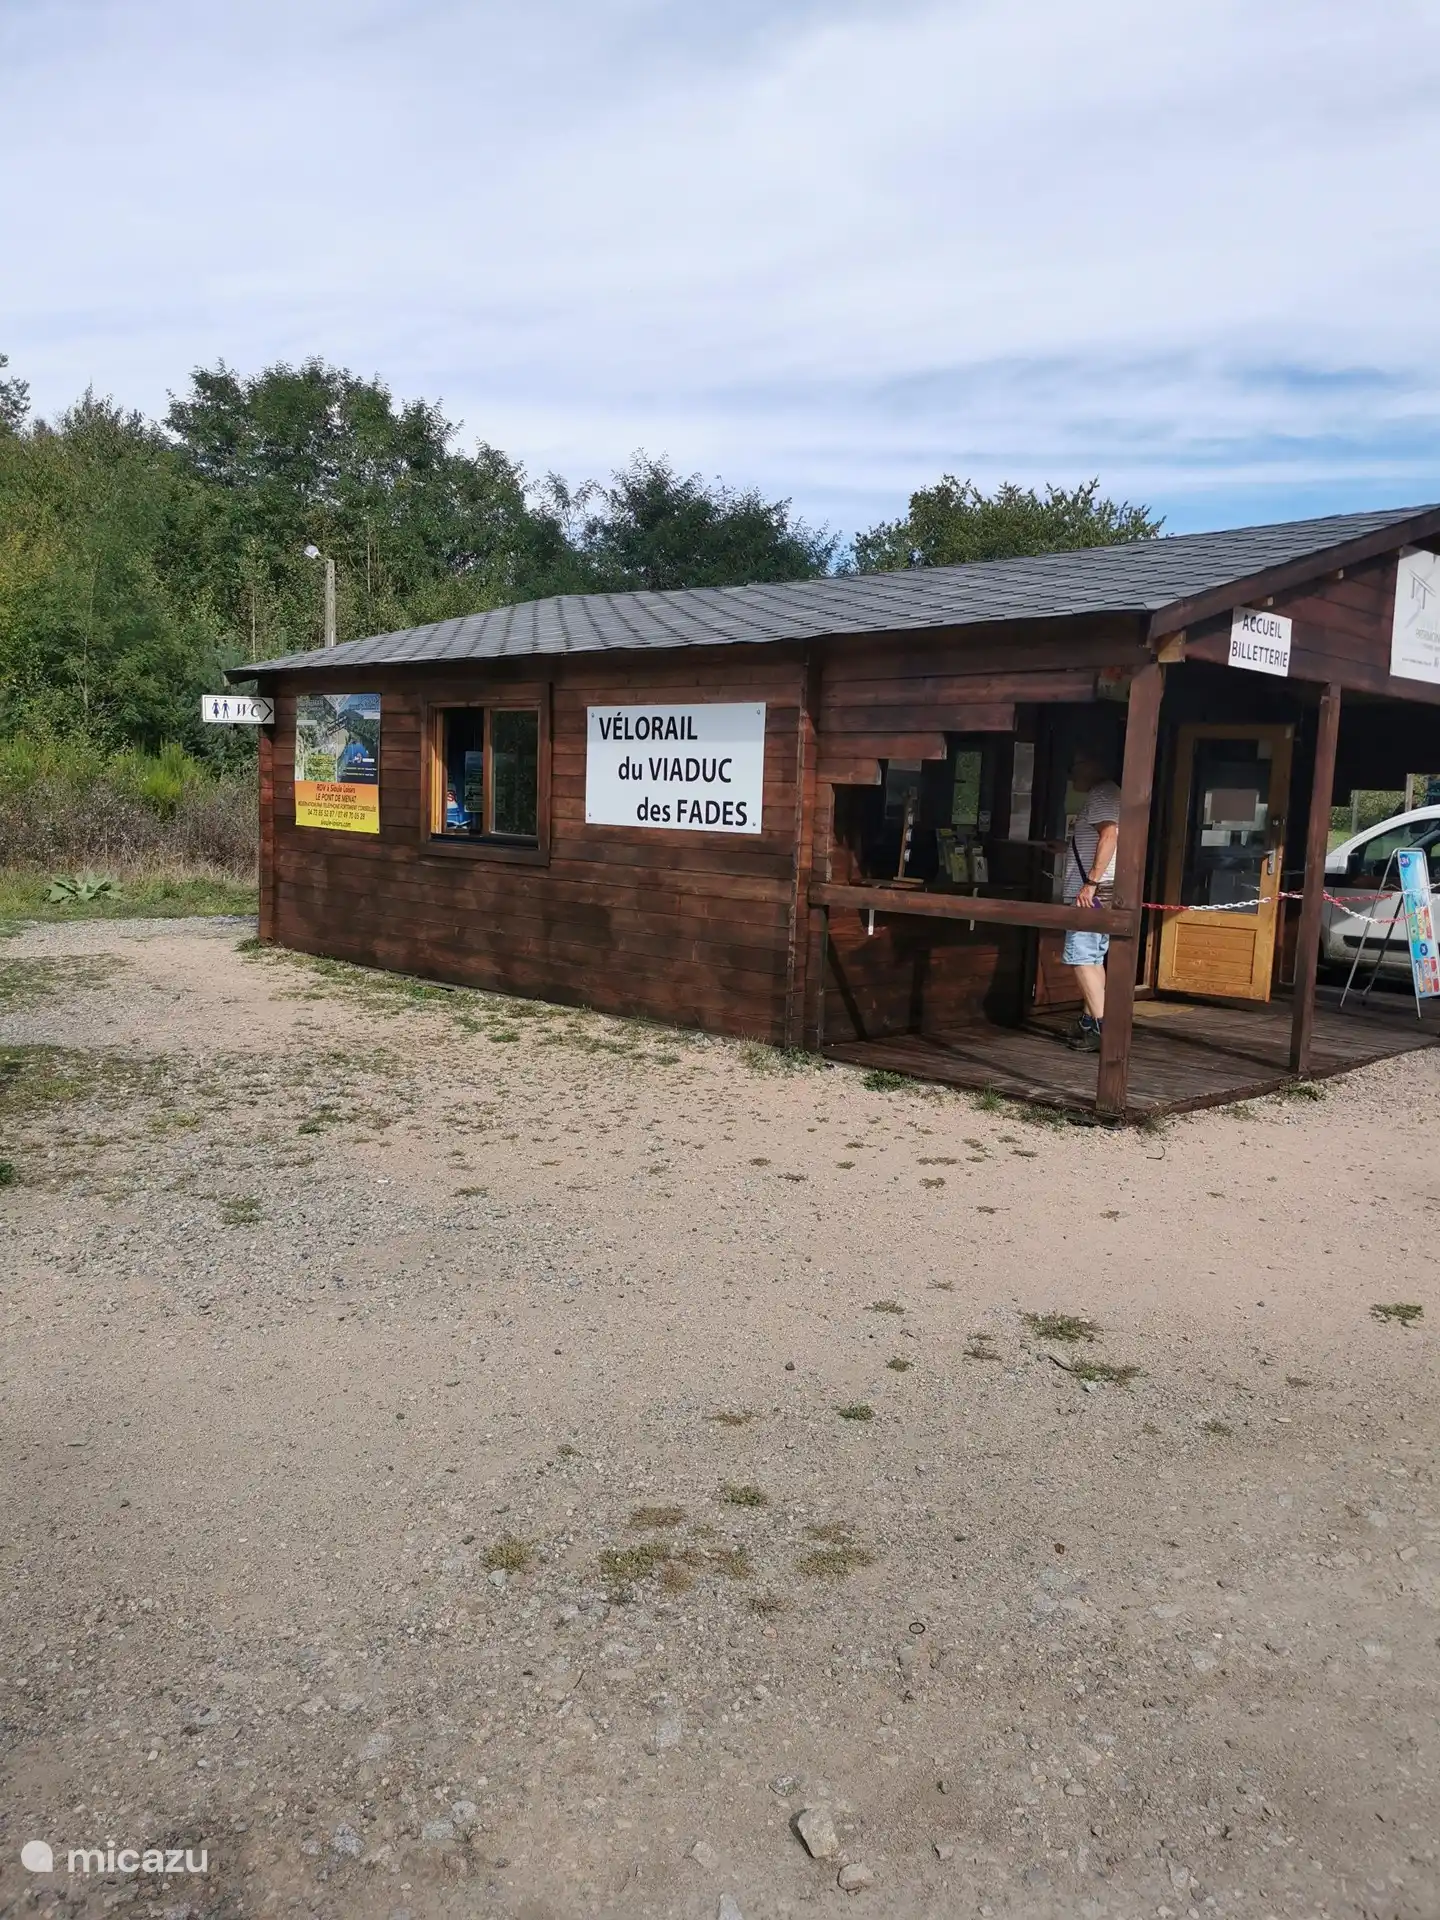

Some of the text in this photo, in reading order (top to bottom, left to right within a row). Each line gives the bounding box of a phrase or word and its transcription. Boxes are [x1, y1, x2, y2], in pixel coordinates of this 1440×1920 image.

[1242, 614, 1282, 639] ACCUEIL
[1231, 641, 1289, 667] BILLETTERIE
[236, 703, 262, 717] WC
[599, 712, 698, 741] VÉLORAIL
[618, 756, 732, 783] du VIADUC
[315, 793, 321, 801] LE
[321, 793, 334, 802] PONT
[335, 794, 341, 803] DE
[637, 796, 748, 827] des FADES
